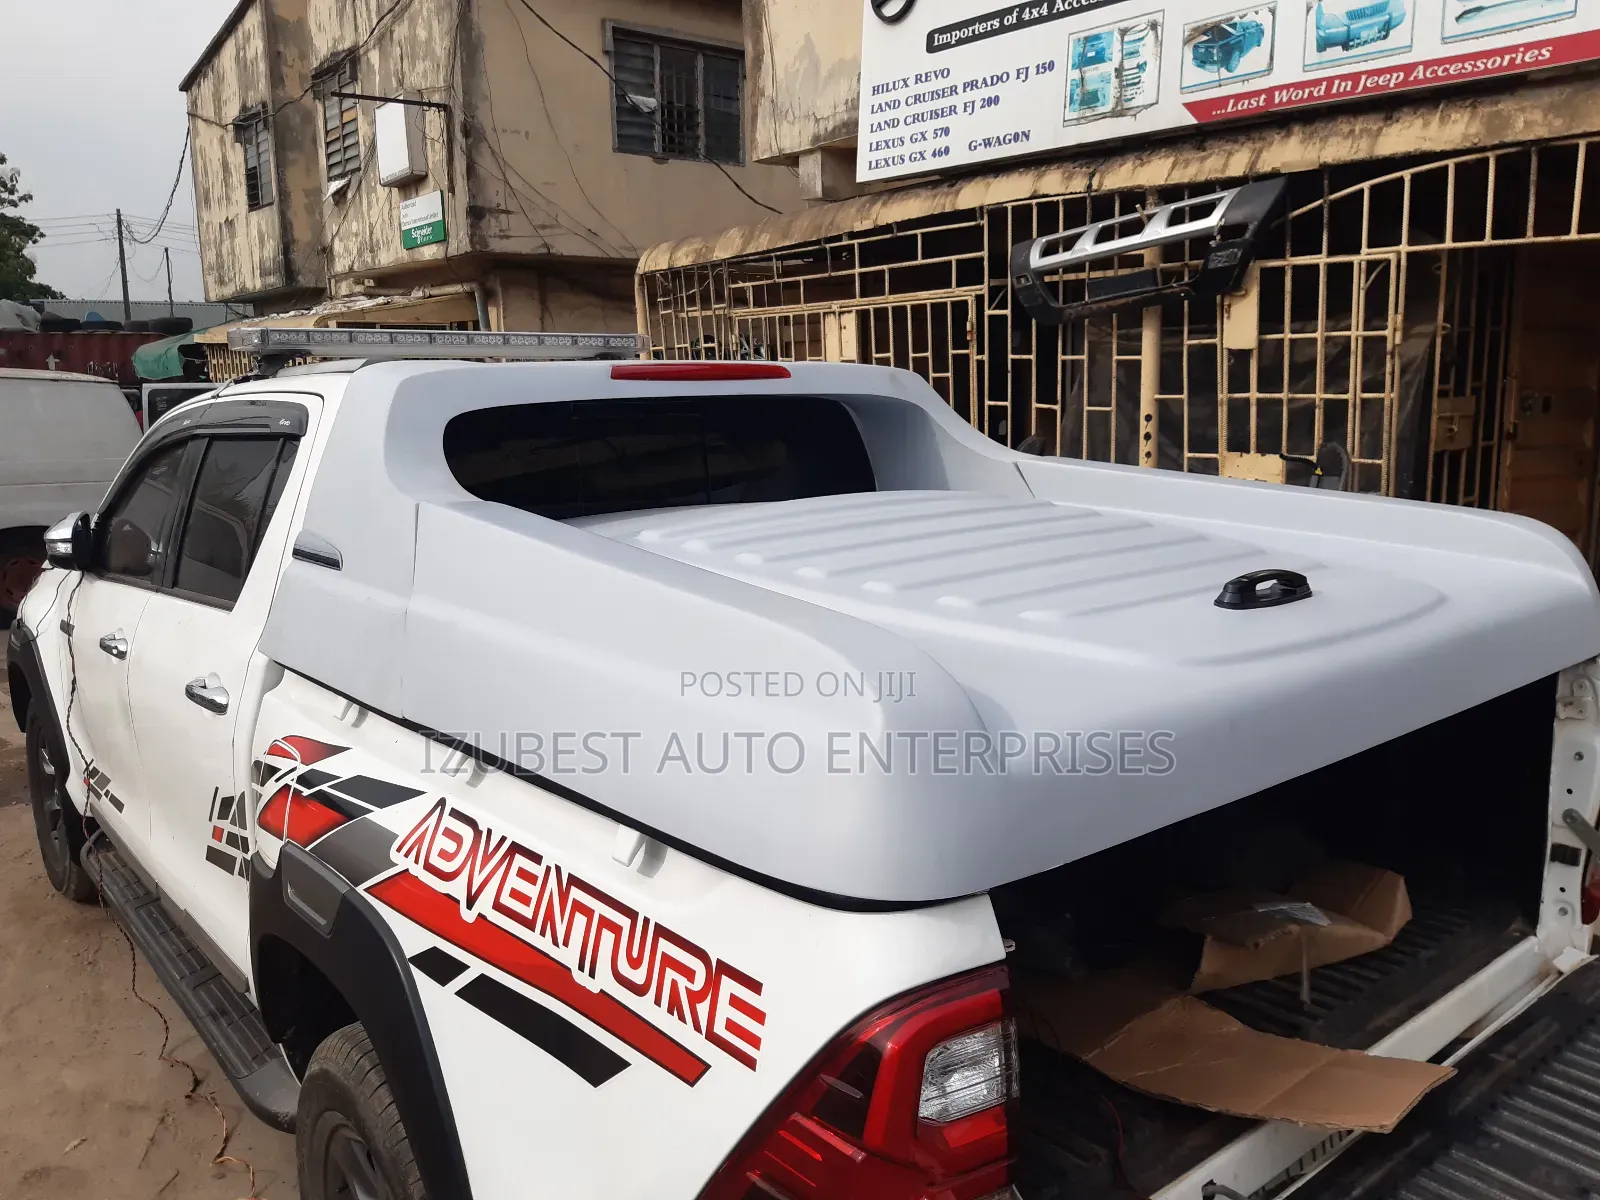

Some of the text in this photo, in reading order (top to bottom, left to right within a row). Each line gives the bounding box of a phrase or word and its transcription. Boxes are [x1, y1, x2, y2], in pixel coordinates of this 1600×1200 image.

[933, 17, 1000, 46] Importers
[1003, 9, 1020, 26] of
[1022, 3, 1048, 21] 4x4
[870, 60, 1055, 115] LAND CRUISER PRADO FJ 150
[871, 67, 951, 96] HILUX REVO
[1274, 81, 1328, 105] Word
[1331, 78, 1352, 94] In
[1355, 70, 1405, 93] Jeep
[1408, 45, 1553, 82] Accessories
[869, 95, 1001, 134] LAND CRUISER FJ 200
[867, 145, 951, 171] LEXUS GX 460
[868, 126, 951, 153] LEXUS GX 570
[394, 796, 767, 1074] ADVENTURE
